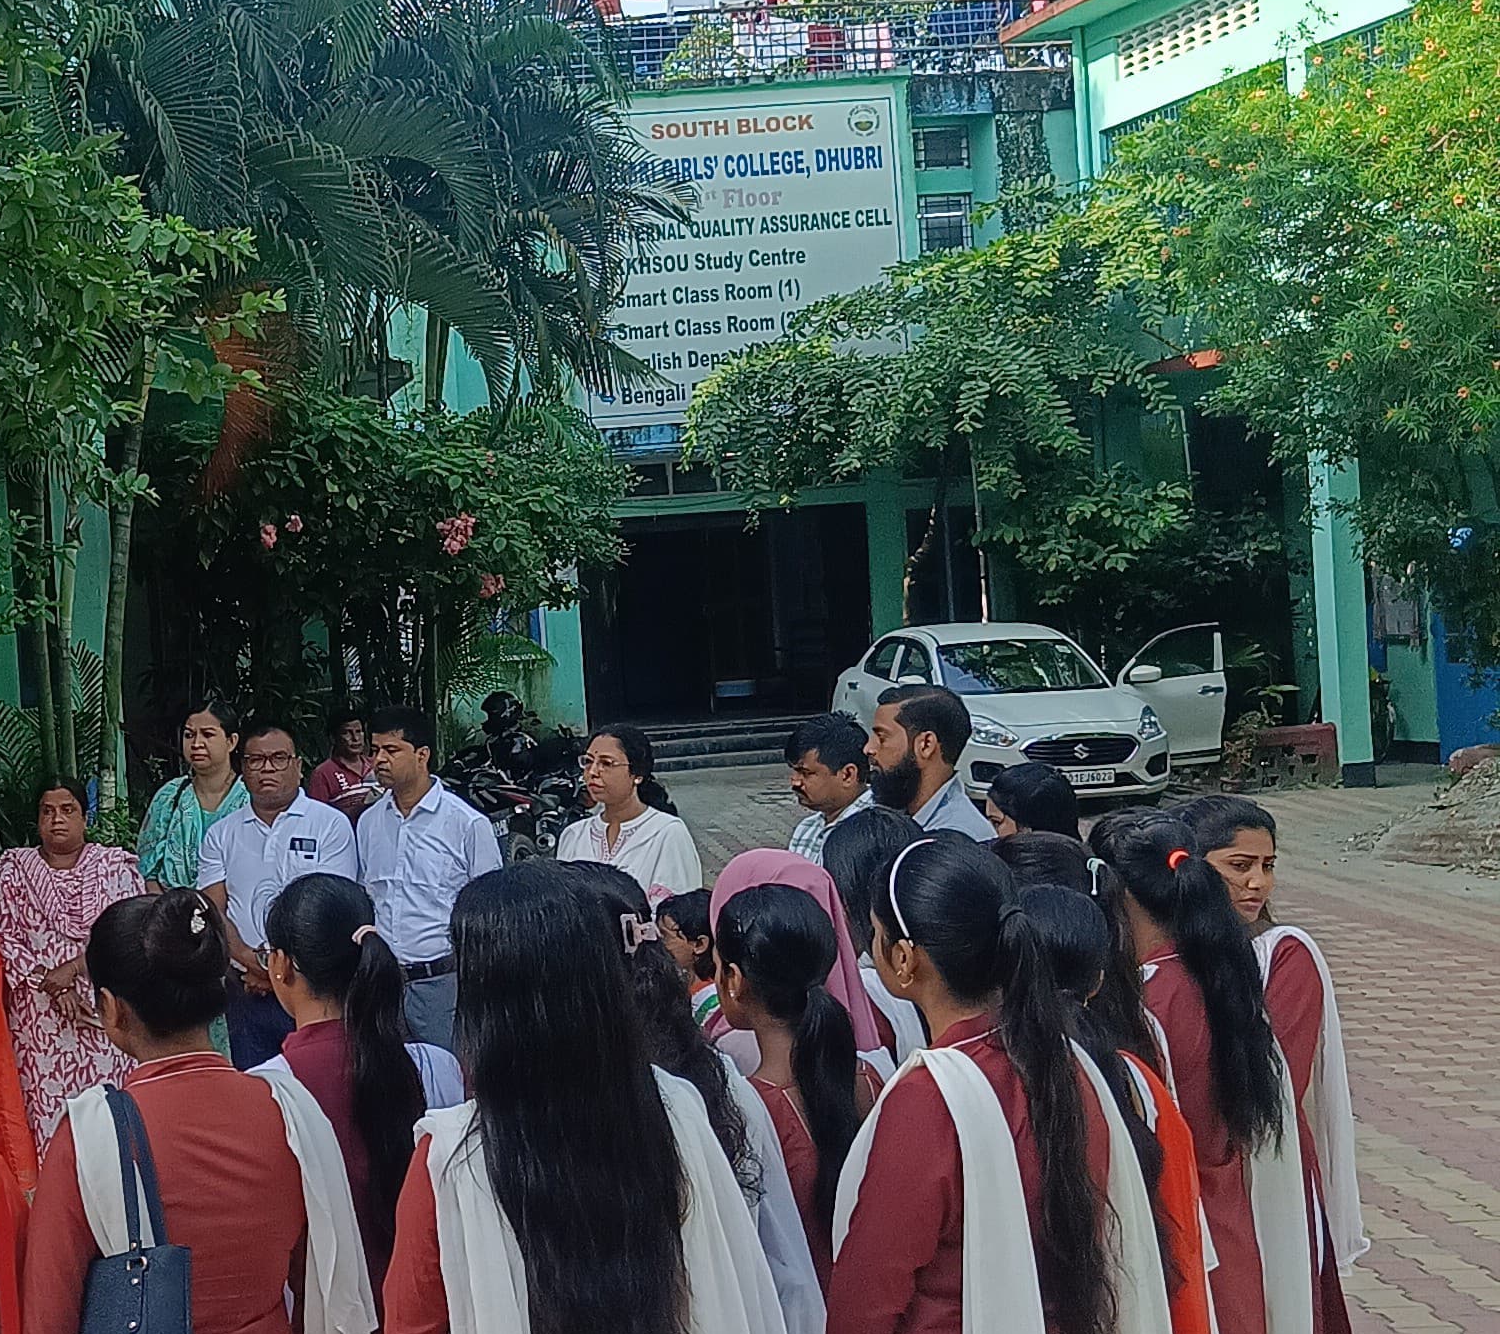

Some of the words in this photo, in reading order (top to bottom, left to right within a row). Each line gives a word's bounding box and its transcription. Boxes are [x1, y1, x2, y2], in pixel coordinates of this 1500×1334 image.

[651, 119, 729, 140] SOUTH
[737, 114, 815, 135] BLOCK
[724, 150, 811, 179] COLLEGE,
[815, 145, 883, 172] DHUBRI
[722, 188, 783, 209] Floor
[690, 218, 755, 240] QUALITY
[760, 211, 851, 235] ASSURANCE
[855, 208, 893, 228] CELL
[694, 251, 744, 273] Study
[748, 248, 807, 268] Centre
[615, 288, 667, 309] Smart
[672, 286, 720, 305] Class
[725, 283, 773, 301] Room
[778, 278, 801, 303] (1)
[617, 320, 670, 341] Smart
[674, 318, 722, 337] Class
[727, 315, 775, 334] Room
[780, 311, 799, 337] (2
[621, 383, 686, 407] Bengali
